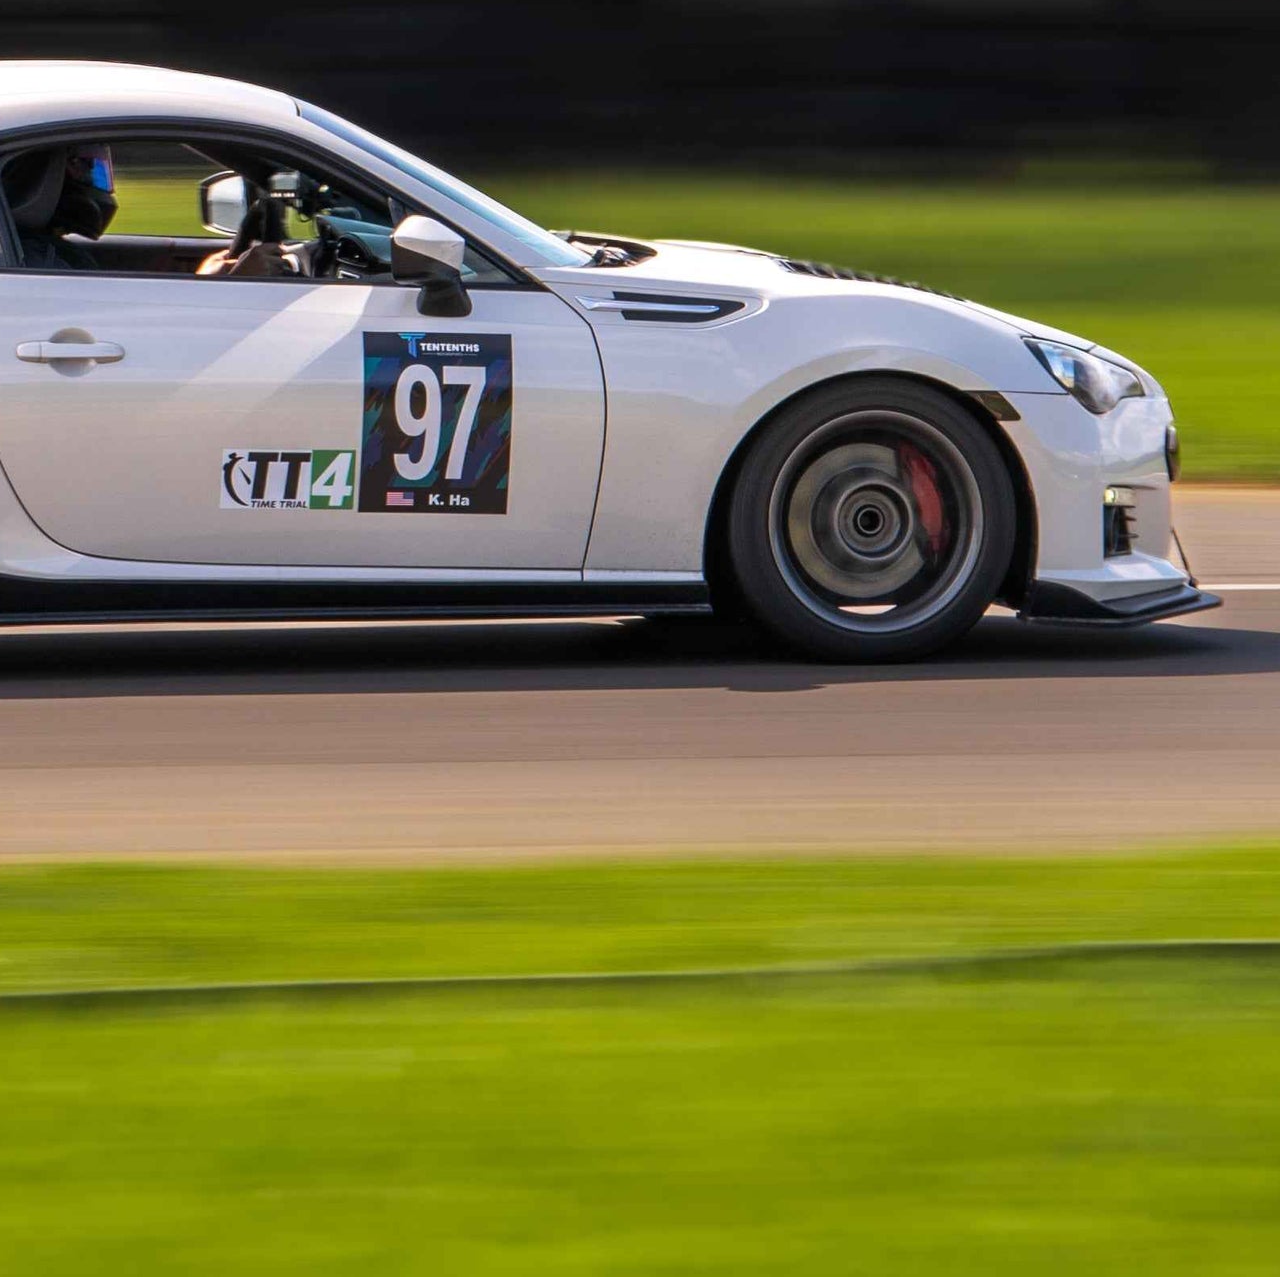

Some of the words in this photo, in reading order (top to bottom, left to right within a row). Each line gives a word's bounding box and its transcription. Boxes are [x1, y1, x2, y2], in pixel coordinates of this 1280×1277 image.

[420, 342, 480, 353] TENTENTHS
[393, 363, 487, 482] 97
[250, 500, 276, 509] TIME
[279, 500, 308, 509] TRIAL
[428, 493, 445, 506] K.
[449, 494, 470, 507] Ha
